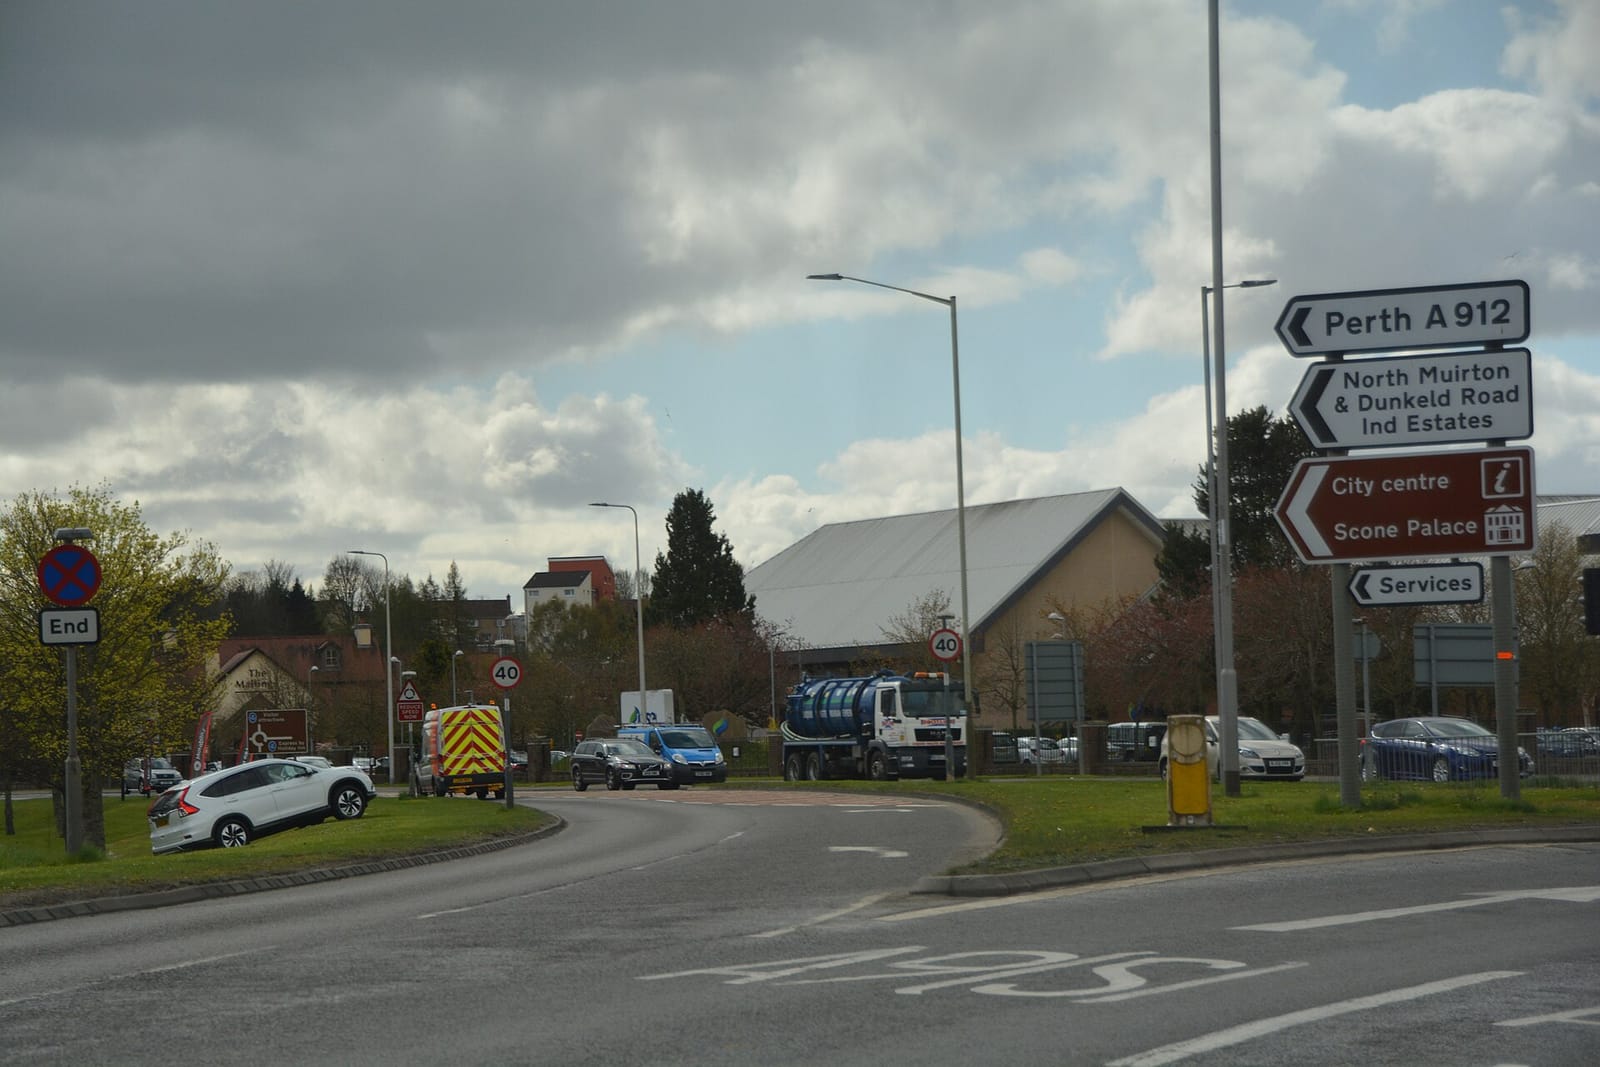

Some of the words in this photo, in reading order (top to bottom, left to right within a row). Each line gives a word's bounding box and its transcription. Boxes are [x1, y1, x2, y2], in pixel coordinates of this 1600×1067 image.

[1325, 307, 1412, 336] Perth
[1343, 368, 1409, 389] North
[1419, 363, 1510, 385] Muirton
[1334, 397, 1349, 413] &
[1358, 390, 1450, 412] Dunkeld
[1461, 385, 1519, 406] Road
[1362, 416, 1397, 435] Ind
[1407, 413, 1493, 432] Estates
[1332, 477, 1374, 497] City
[1381, 474, 1449, 492] centre
[1334, 523, 1398, 541] Scone
[1407, 518, 1478, 537] Palace
[1379, 575, 1472, 594] Services
[50, 618, 88, 634] End
[935, 638, 957, 652] 40
[248, 669, 267, 678] The
[495, 666, 518, 680] 40
